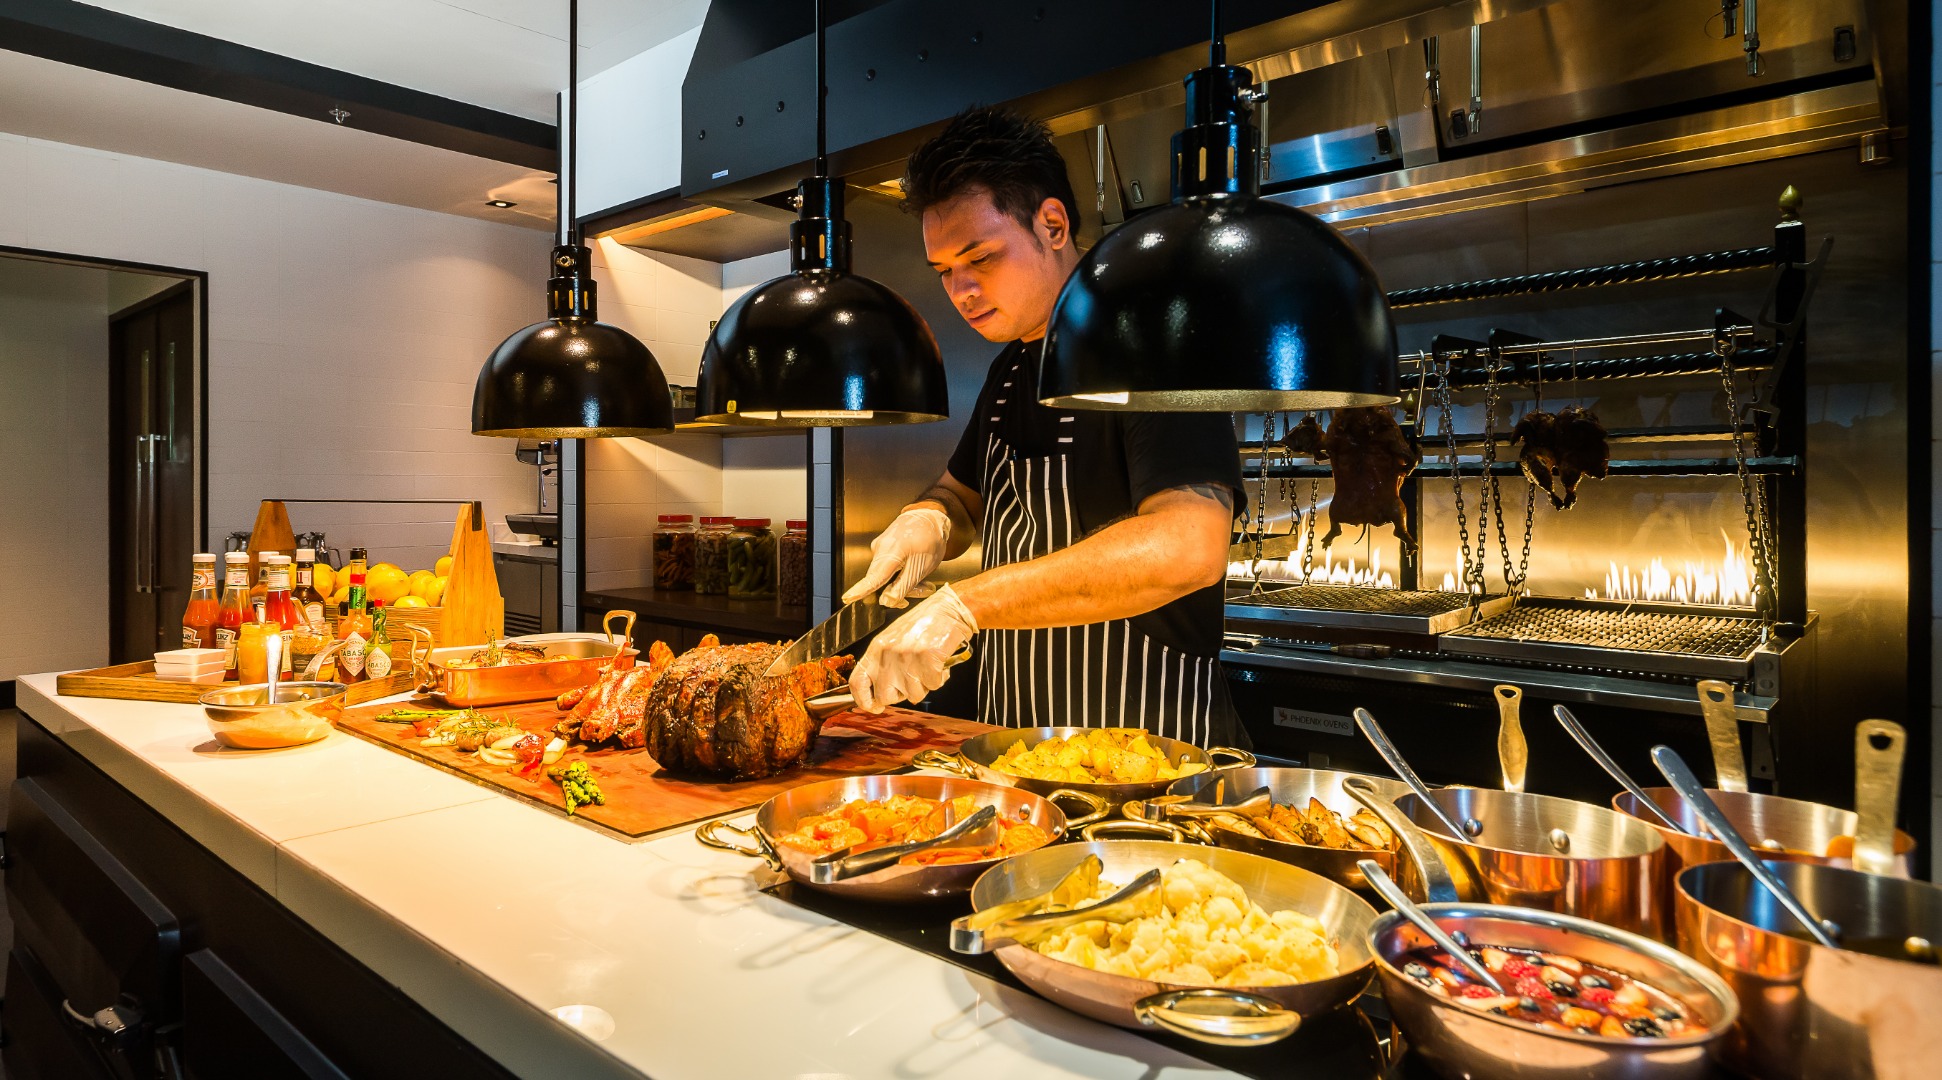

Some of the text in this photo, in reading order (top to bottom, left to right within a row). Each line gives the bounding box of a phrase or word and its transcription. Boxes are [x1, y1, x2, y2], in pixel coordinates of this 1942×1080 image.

[340, 648, 367, 657] TABASC
[1290, 714, 1349, 730] PHOENIX OVENS
